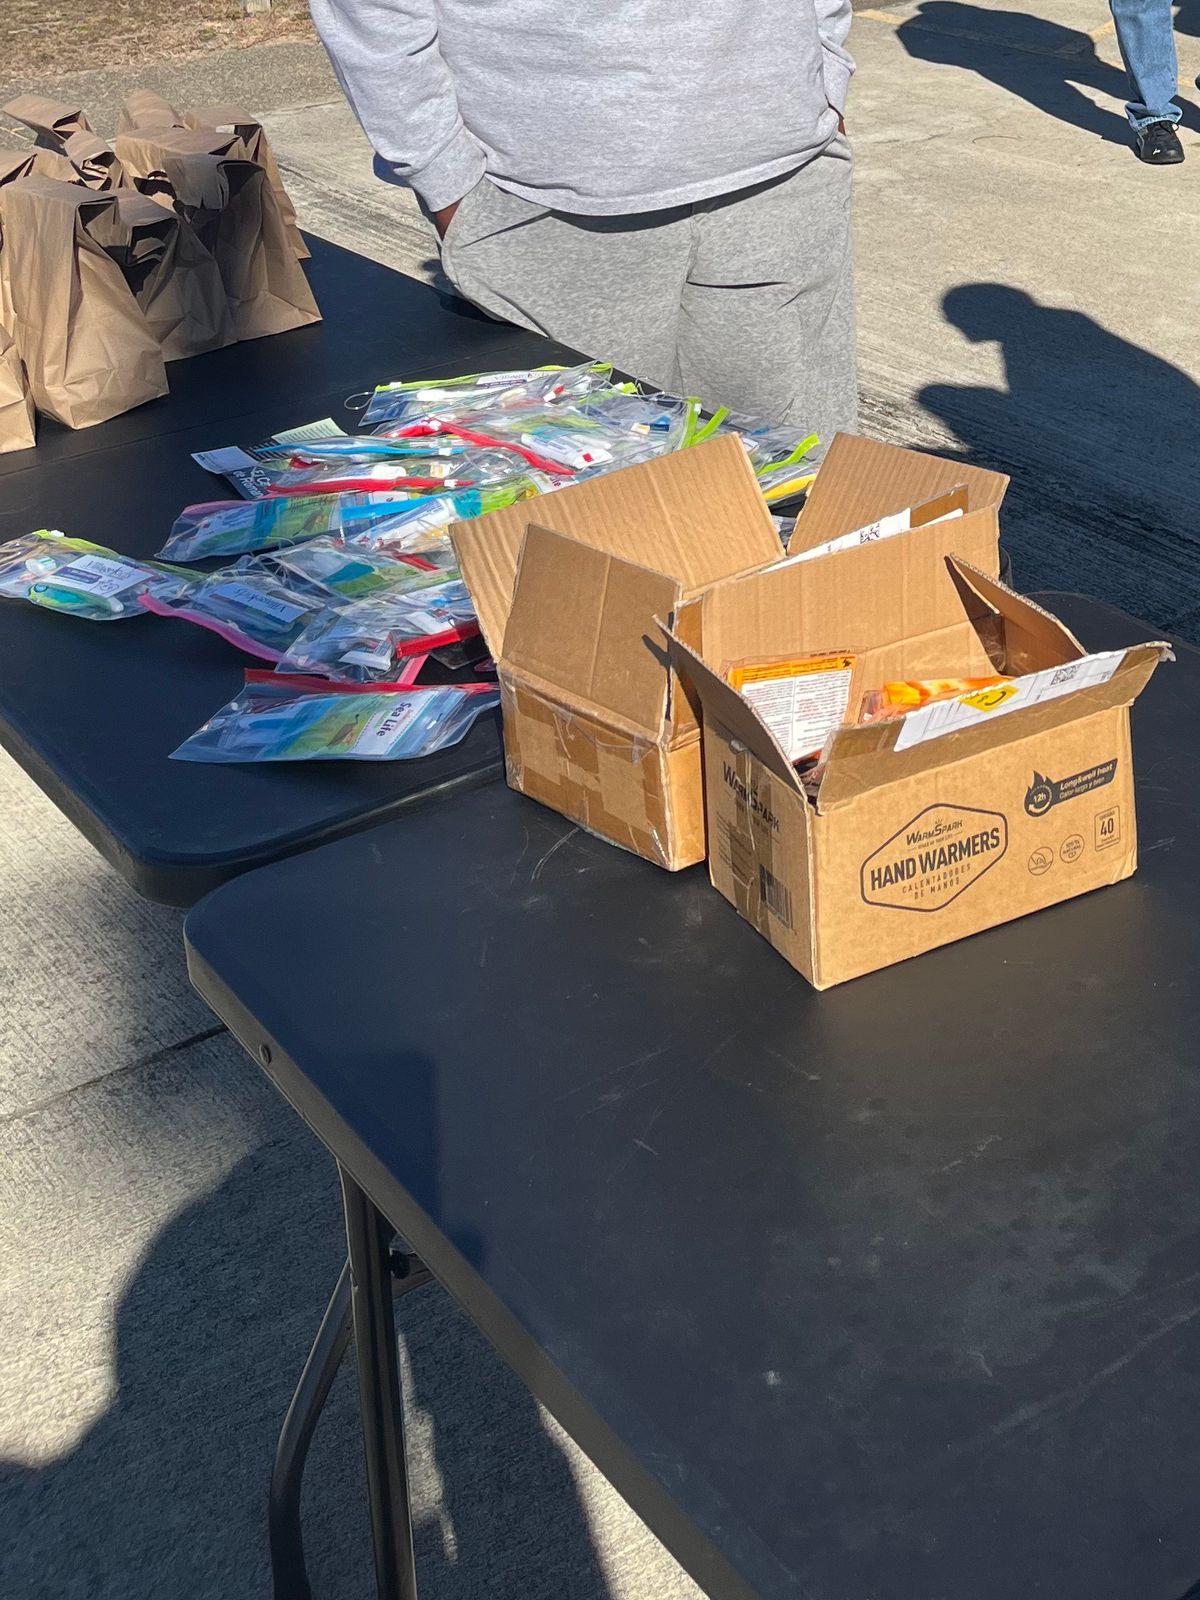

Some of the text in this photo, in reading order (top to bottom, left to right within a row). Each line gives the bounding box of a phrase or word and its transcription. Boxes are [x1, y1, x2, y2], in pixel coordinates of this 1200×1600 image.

[391, 702, 412, 718] Sea
[376, 718, 396, 737] Life
[1033, 793, 1047, 803] 12h
[1100, 817, 1114, 836] 40
[870, 827, 1000, 891] HAND WARMERS
[902, 863, 971, 894] CALENTADORES
[914, 877, 960, 900] DE MANOS
